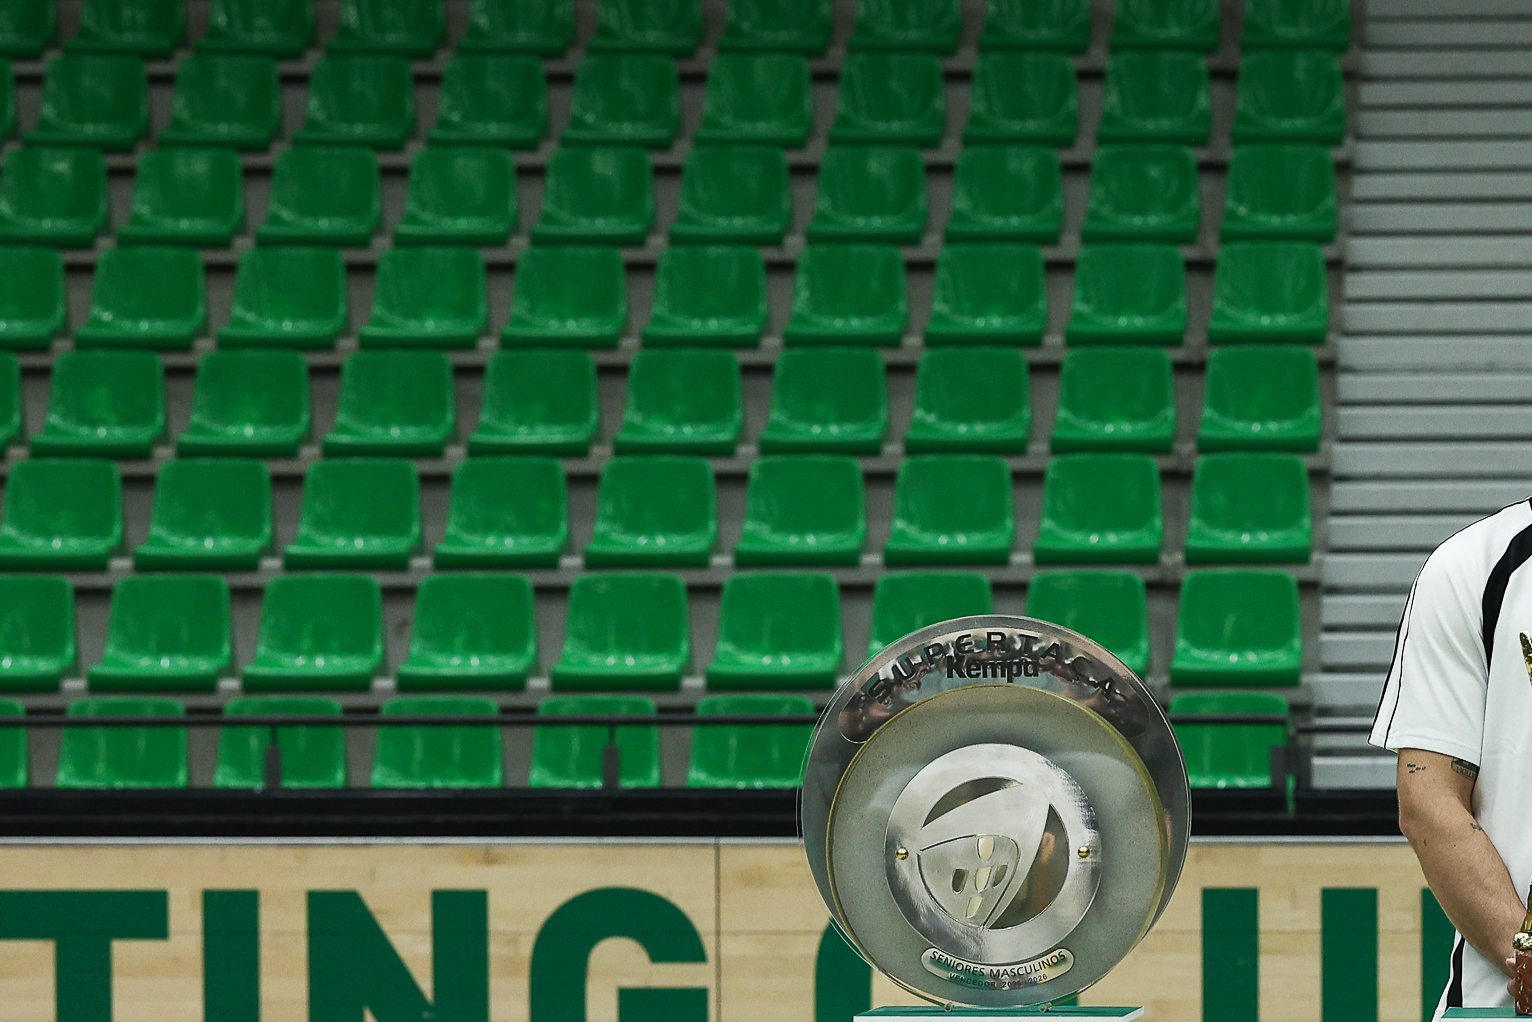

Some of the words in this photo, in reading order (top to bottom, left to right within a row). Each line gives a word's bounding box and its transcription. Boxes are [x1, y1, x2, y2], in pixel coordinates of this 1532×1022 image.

[867, 631, 1117, 701] SUPERTAÇA
[946, 654, 1040, 683] Kempa
[930, 951, 985, 977] SENIORES
[989, 951, 1066, 978] MASCULINOS
[950, 973, 996, 988] VENCEDOR
